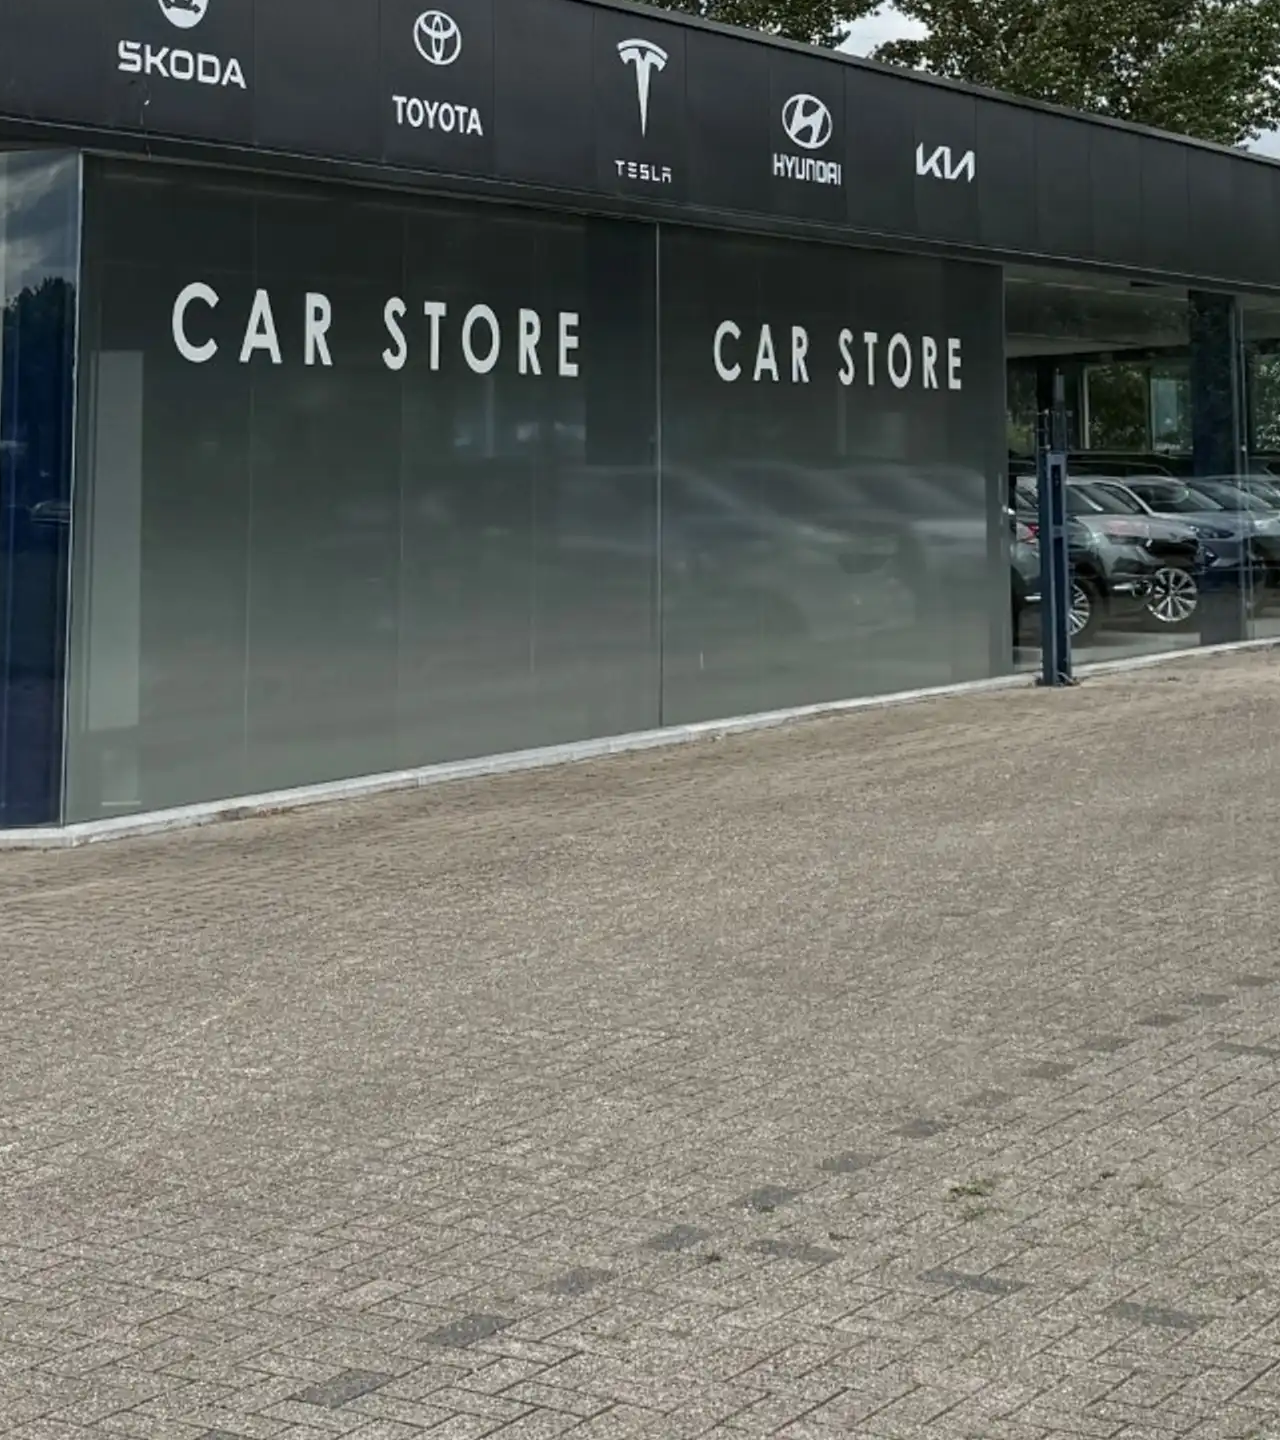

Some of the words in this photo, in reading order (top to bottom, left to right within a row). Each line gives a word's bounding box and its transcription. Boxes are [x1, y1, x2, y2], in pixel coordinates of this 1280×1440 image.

[391, 95, 483, 136] TOYOTA
[615, 160, 672, 184] TESLA
[773, 153, 841, 186] HYUNDAI
[915, 142, 976, 183] KIA
[171, 282, 334, 367] CAR
[381, 296, 581, 378] STORE
[712, 319, 810, 384] CAR
[837, 327, 963, 391] STORE
